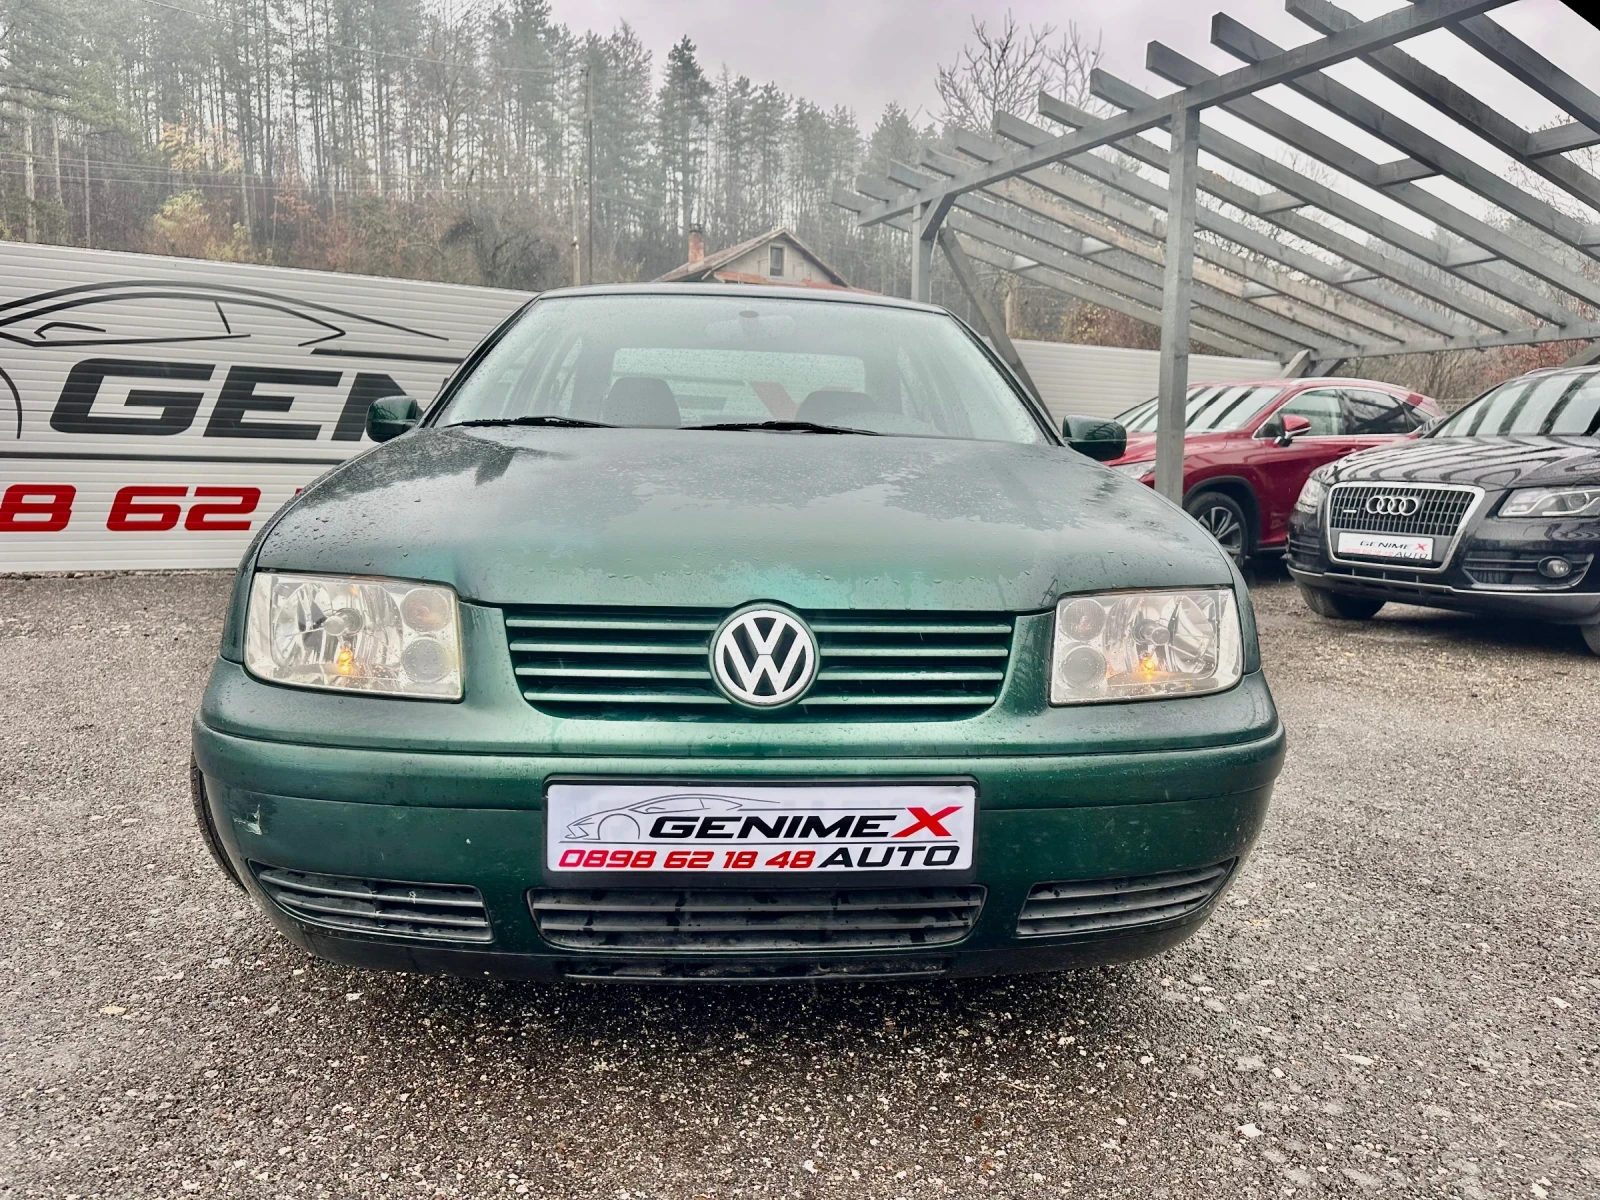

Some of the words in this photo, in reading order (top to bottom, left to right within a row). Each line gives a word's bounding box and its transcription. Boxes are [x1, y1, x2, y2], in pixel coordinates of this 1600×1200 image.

[106, 486, 262, 531] 62
[649, 806, 964, 838] GENIMEX
[558, 849, 657, 869] 0898
[663, 850, 715, 869] 62
[722, 851, 759, 869] 18
[765, 850, 817, 869] 48
[817, 845, 960, 868] AUTO
